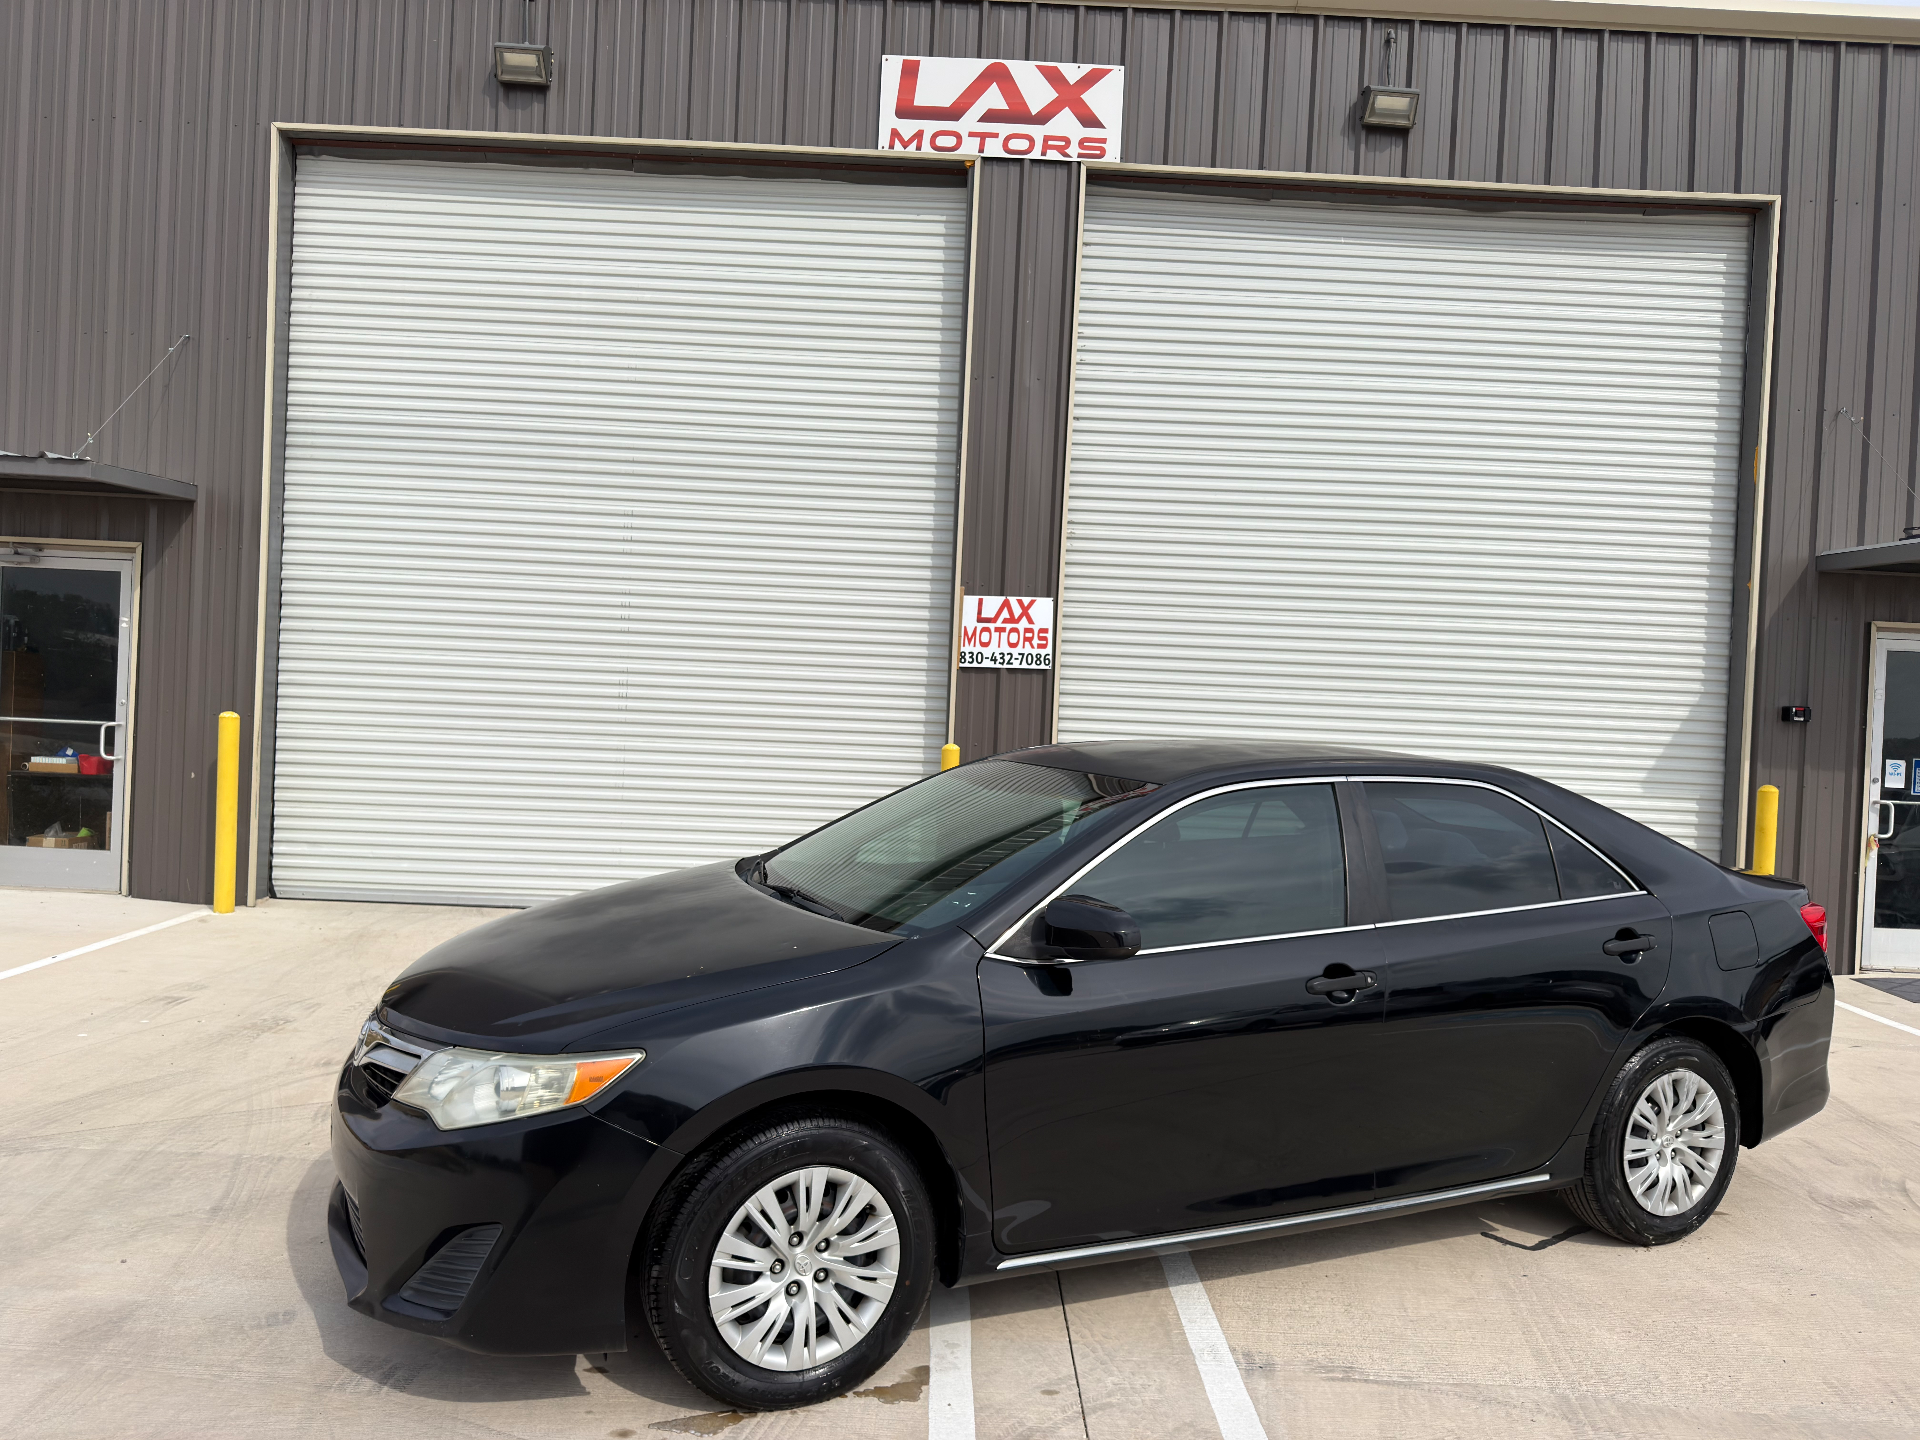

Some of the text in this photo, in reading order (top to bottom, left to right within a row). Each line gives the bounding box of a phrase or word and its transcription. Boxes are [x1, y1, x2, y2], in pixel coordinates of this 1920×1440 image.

[895, 59, 1114, 129] LAX
[888, 128, 1108, 159] MOTORS
[976, 597, 1037, 625] LAX
[962, 625, 1049, 649] MOTORS
[959, 651, 1051, 666] 830-432-7086
